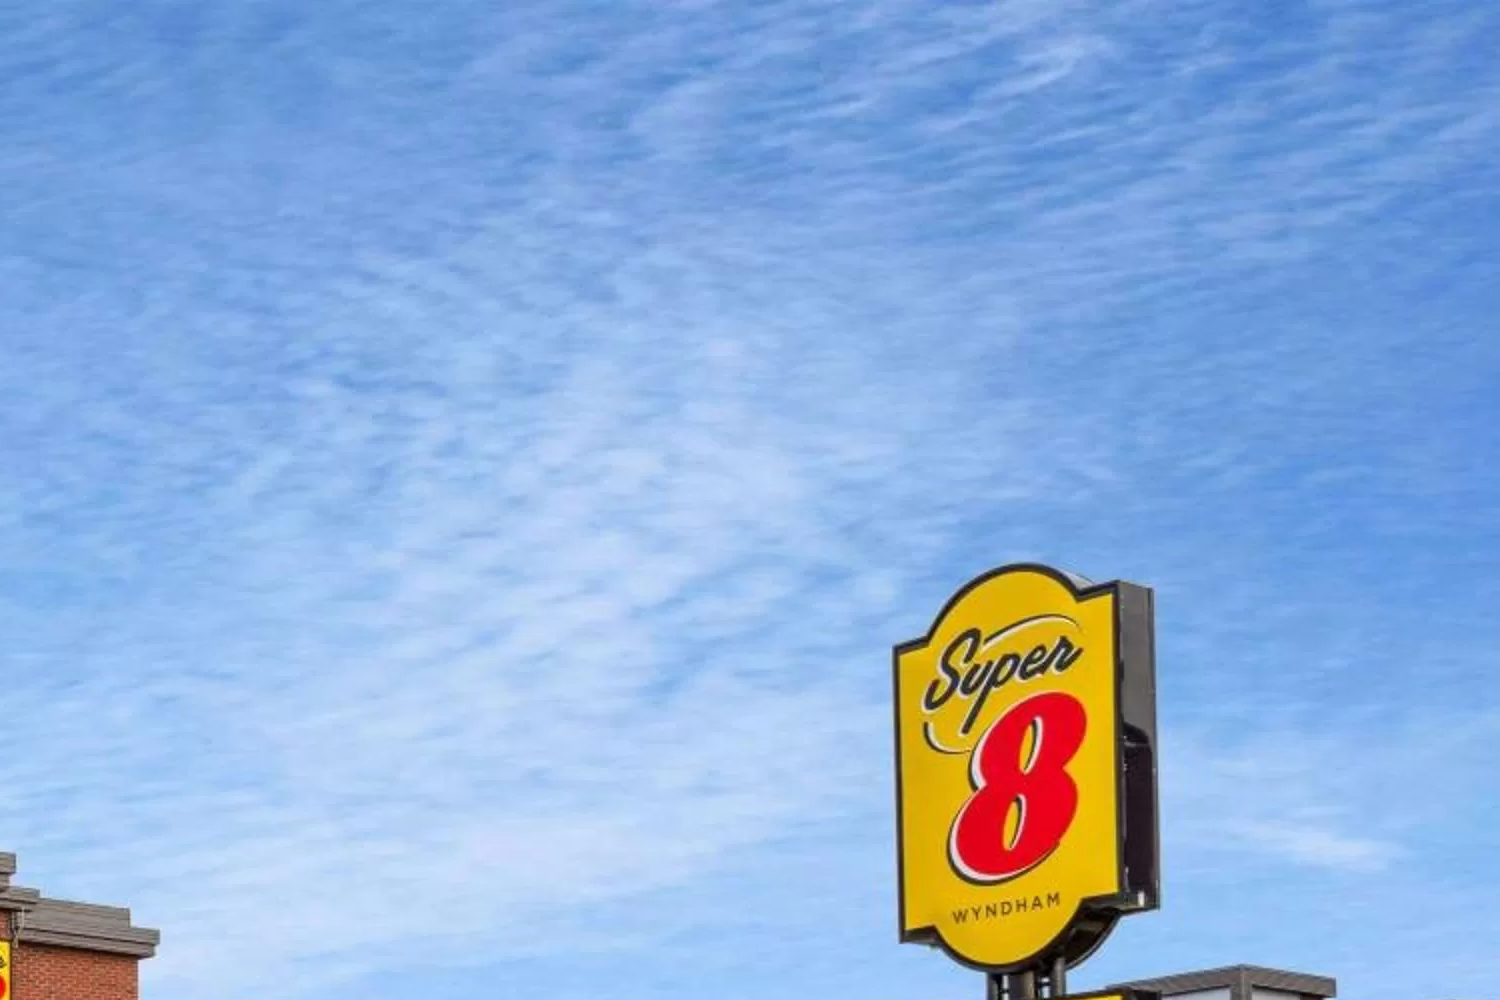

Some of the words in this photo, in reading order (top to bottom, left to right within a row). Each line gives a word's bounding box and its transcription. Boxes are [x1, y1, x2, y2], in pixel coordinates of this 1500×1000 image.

[922, 626, 1085, 736] Super
[946, 690, 1088, 887] 8
[951, 890, 1061, 924] WYNDHAM
